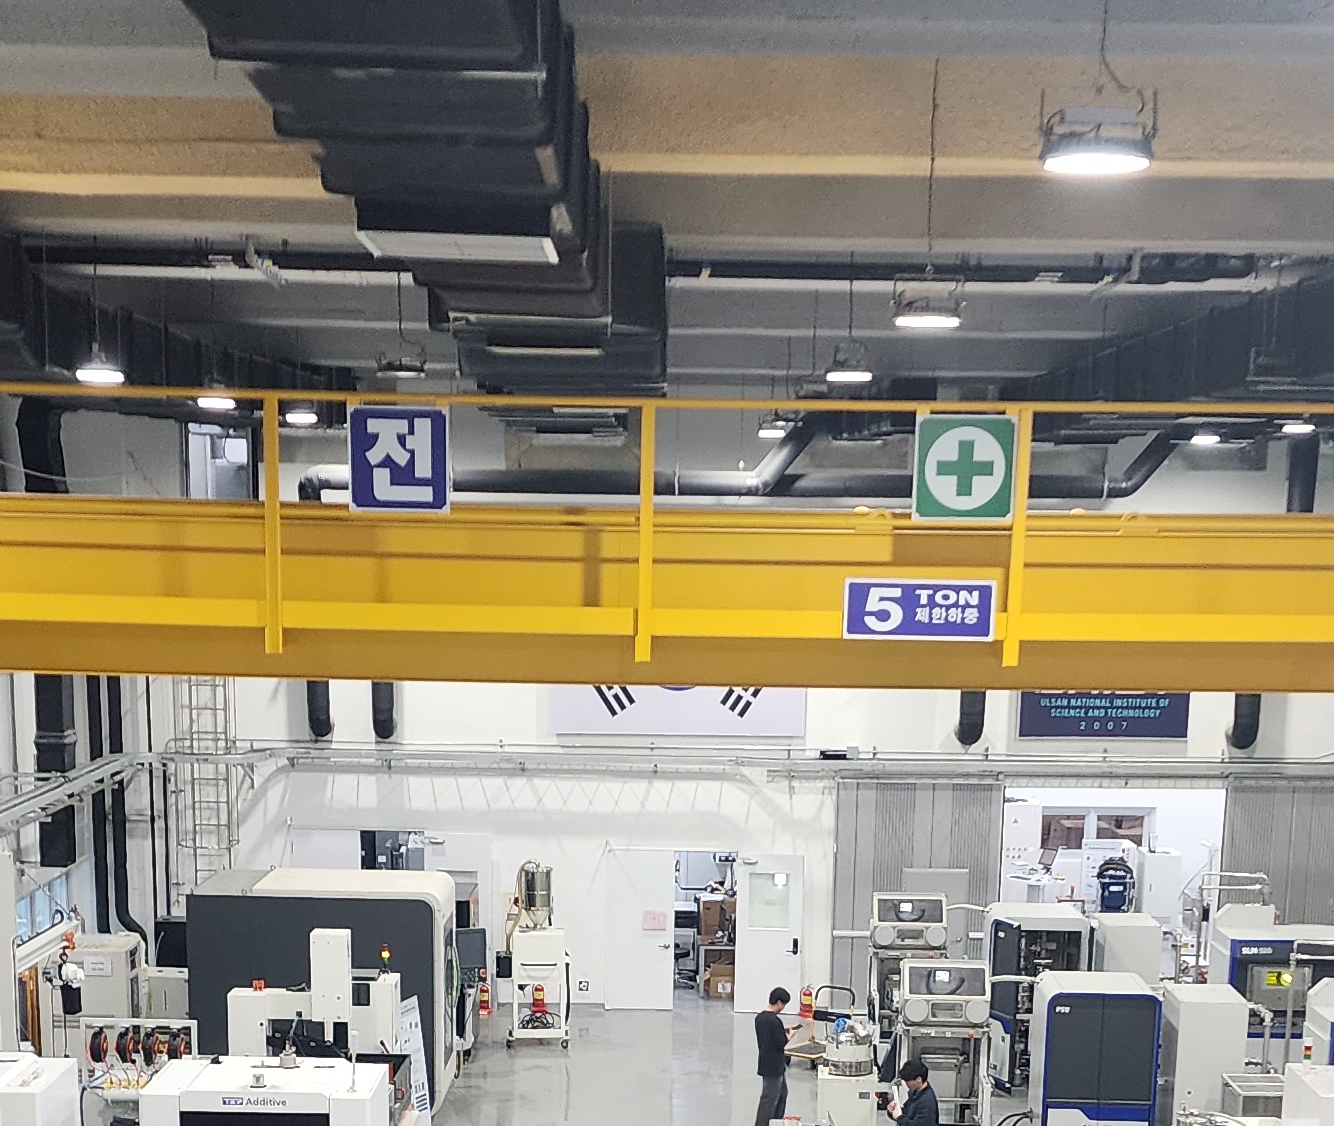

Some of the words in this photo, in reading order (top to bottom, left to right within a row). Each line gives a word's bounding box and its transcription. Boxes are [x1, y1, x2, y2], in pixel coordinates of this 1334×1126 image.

[364, 417, 434, 502] 전
[863, 587, 904, 632] 5
[914, 589, 980, 606] TON
[914, 606, 980, 624] 제한하중
[1040, 698, 1068, 706] ULSAN
[1070, 698, 1111, 706] NATIONAL
[1113, 698, 1157, 707] INSTITUTE
[1159, 698, 1170, 707] OF
[1050, 708, 1085, 717] SCIENCE
[1087, 708, 1105, 717] AND
[1107, 708, 1161, 717] TECHNOLOGY
[245, 1097, 287, 1106] Additive
